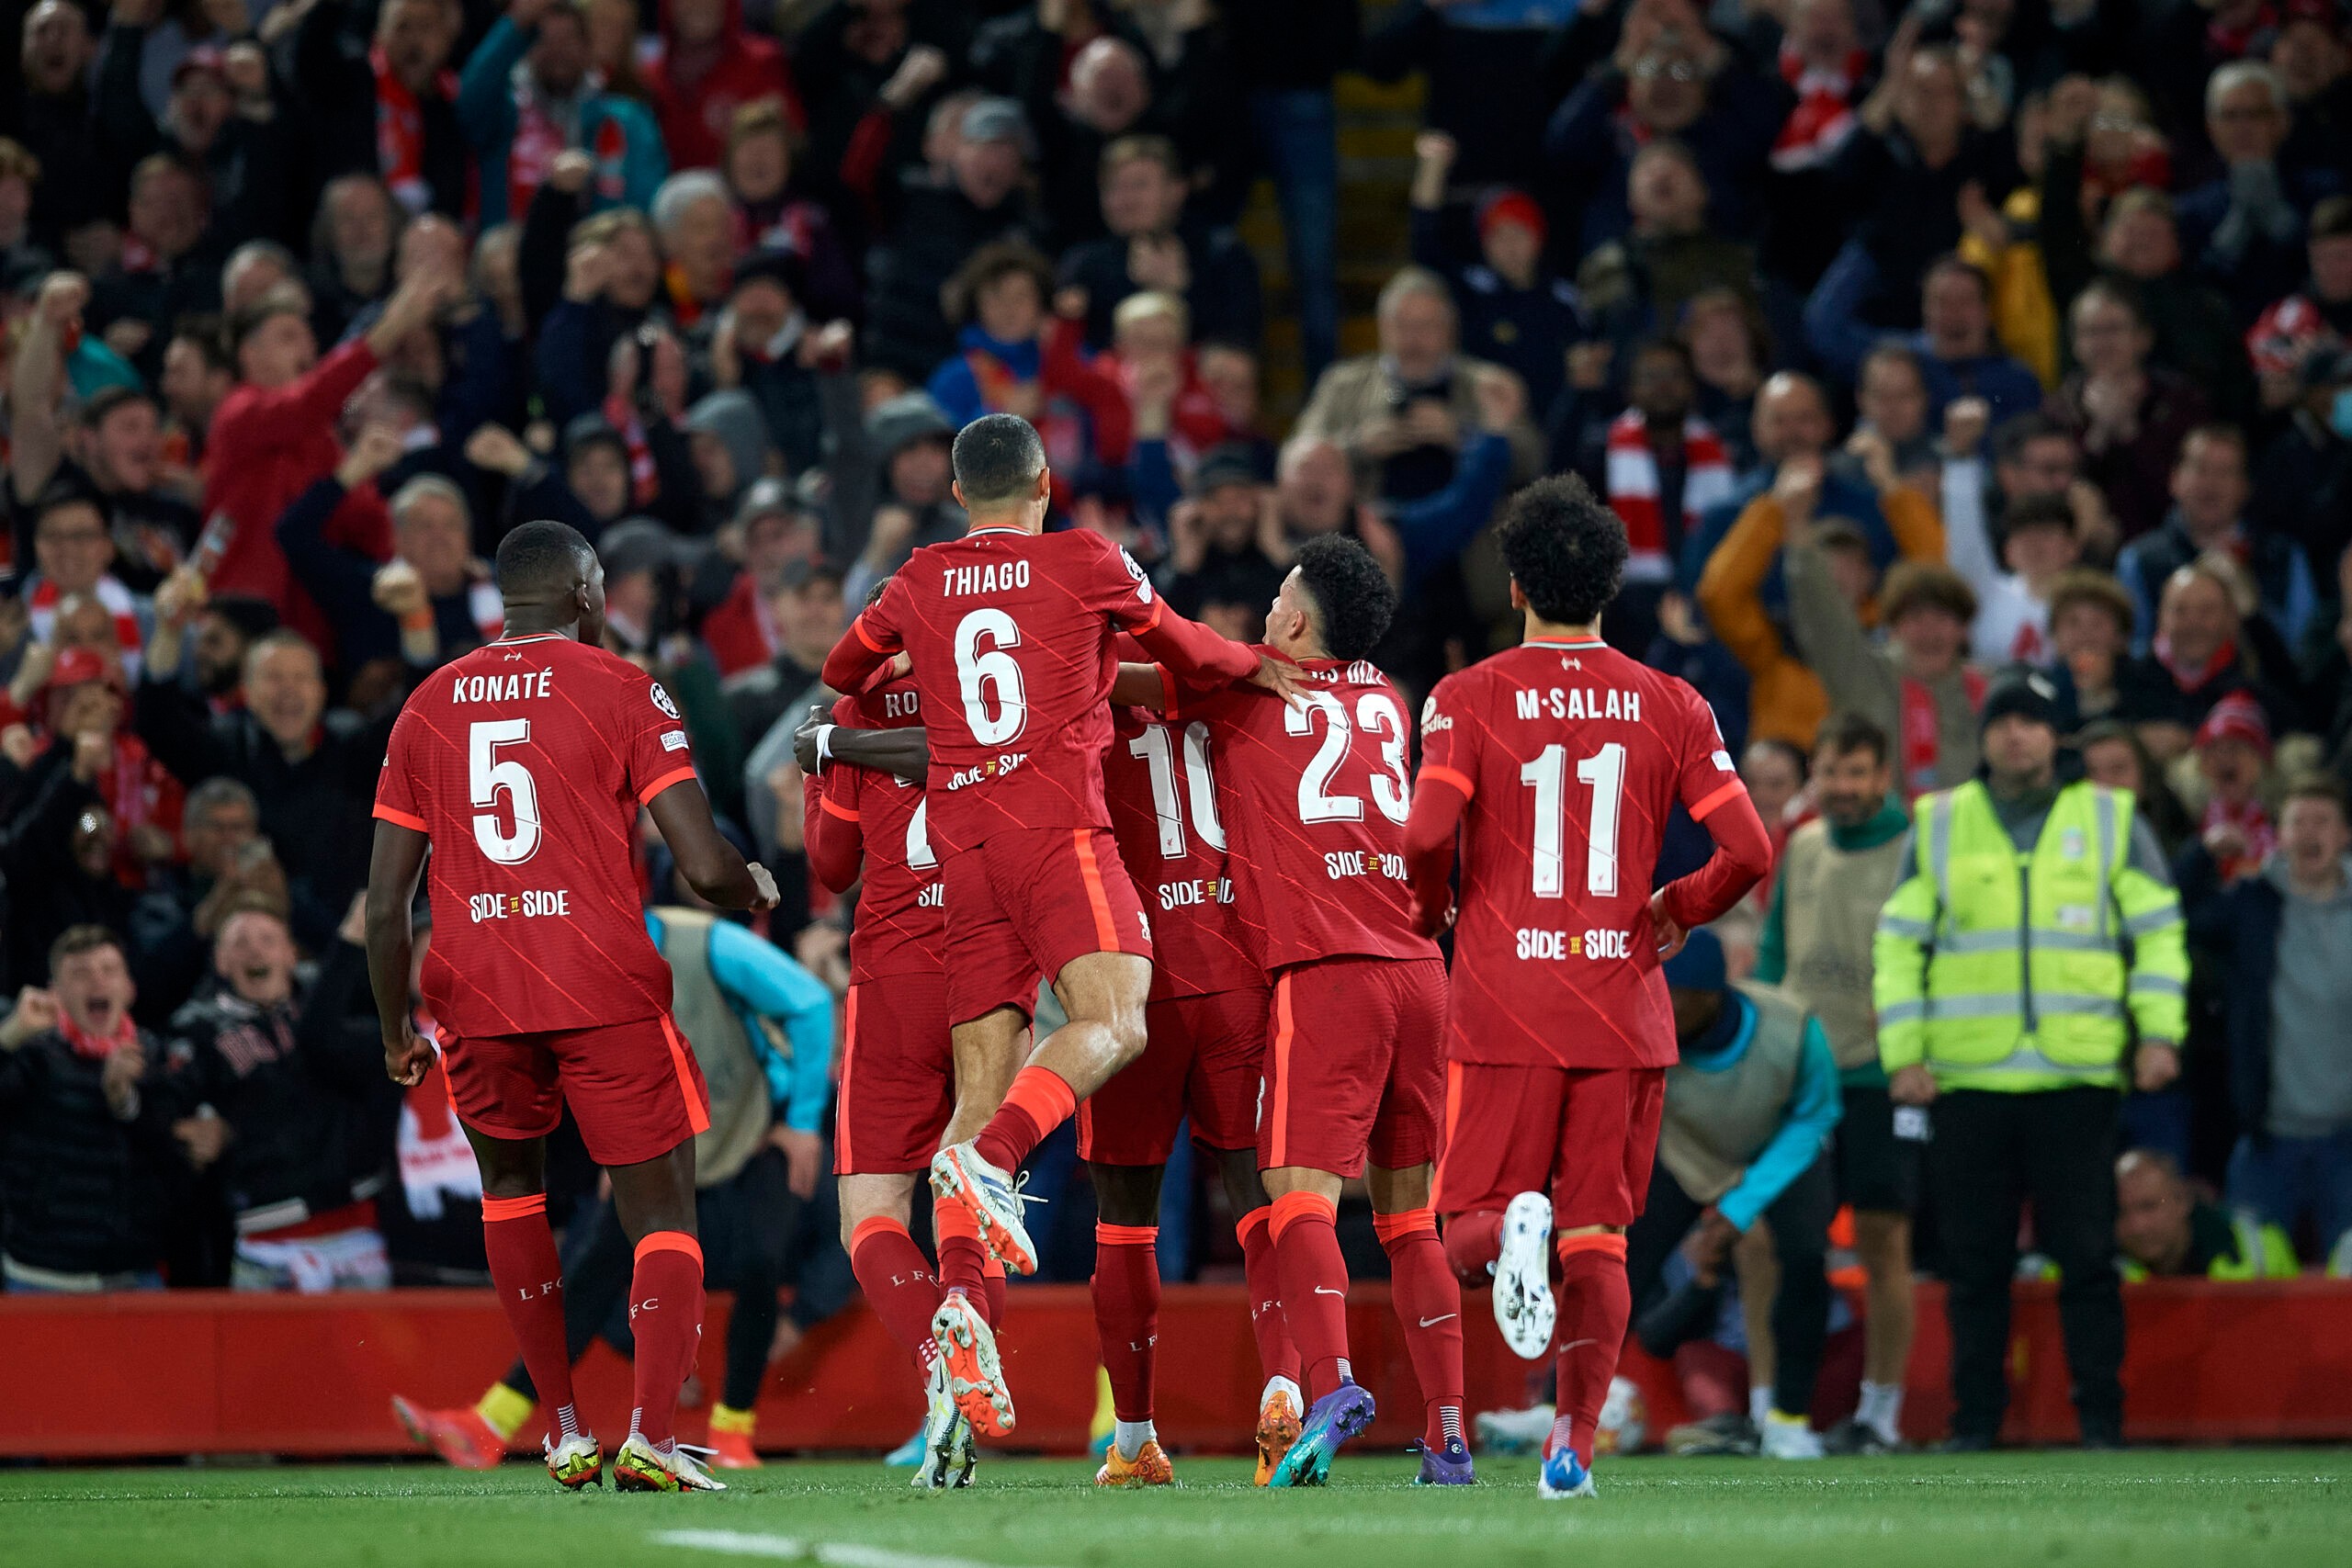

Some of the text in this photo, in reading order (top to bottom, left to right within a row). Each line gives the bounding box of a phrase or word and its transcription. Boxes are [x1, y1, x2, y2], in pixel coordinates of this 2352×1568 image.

[943, 559, 1030, 597] THIAGO
[453, 667, 553, 703] KONATÉ
[954, 608, 1028, 747] 6
[1283, 690, 1411, 828] 23
[469, 717, 542, 865] 5
[1520, 742, 1626, 898] 11
[1324, 850, 1367, 879] SIDE
[469, 893, 508, 923] SIDE
[522, 889, 571, 918] SIDE
[1158, 879, 1205, 910] SIDE
[1516, 928, 1567, 960] SIDE
[1584, 928, 1632, 960] SIDE
